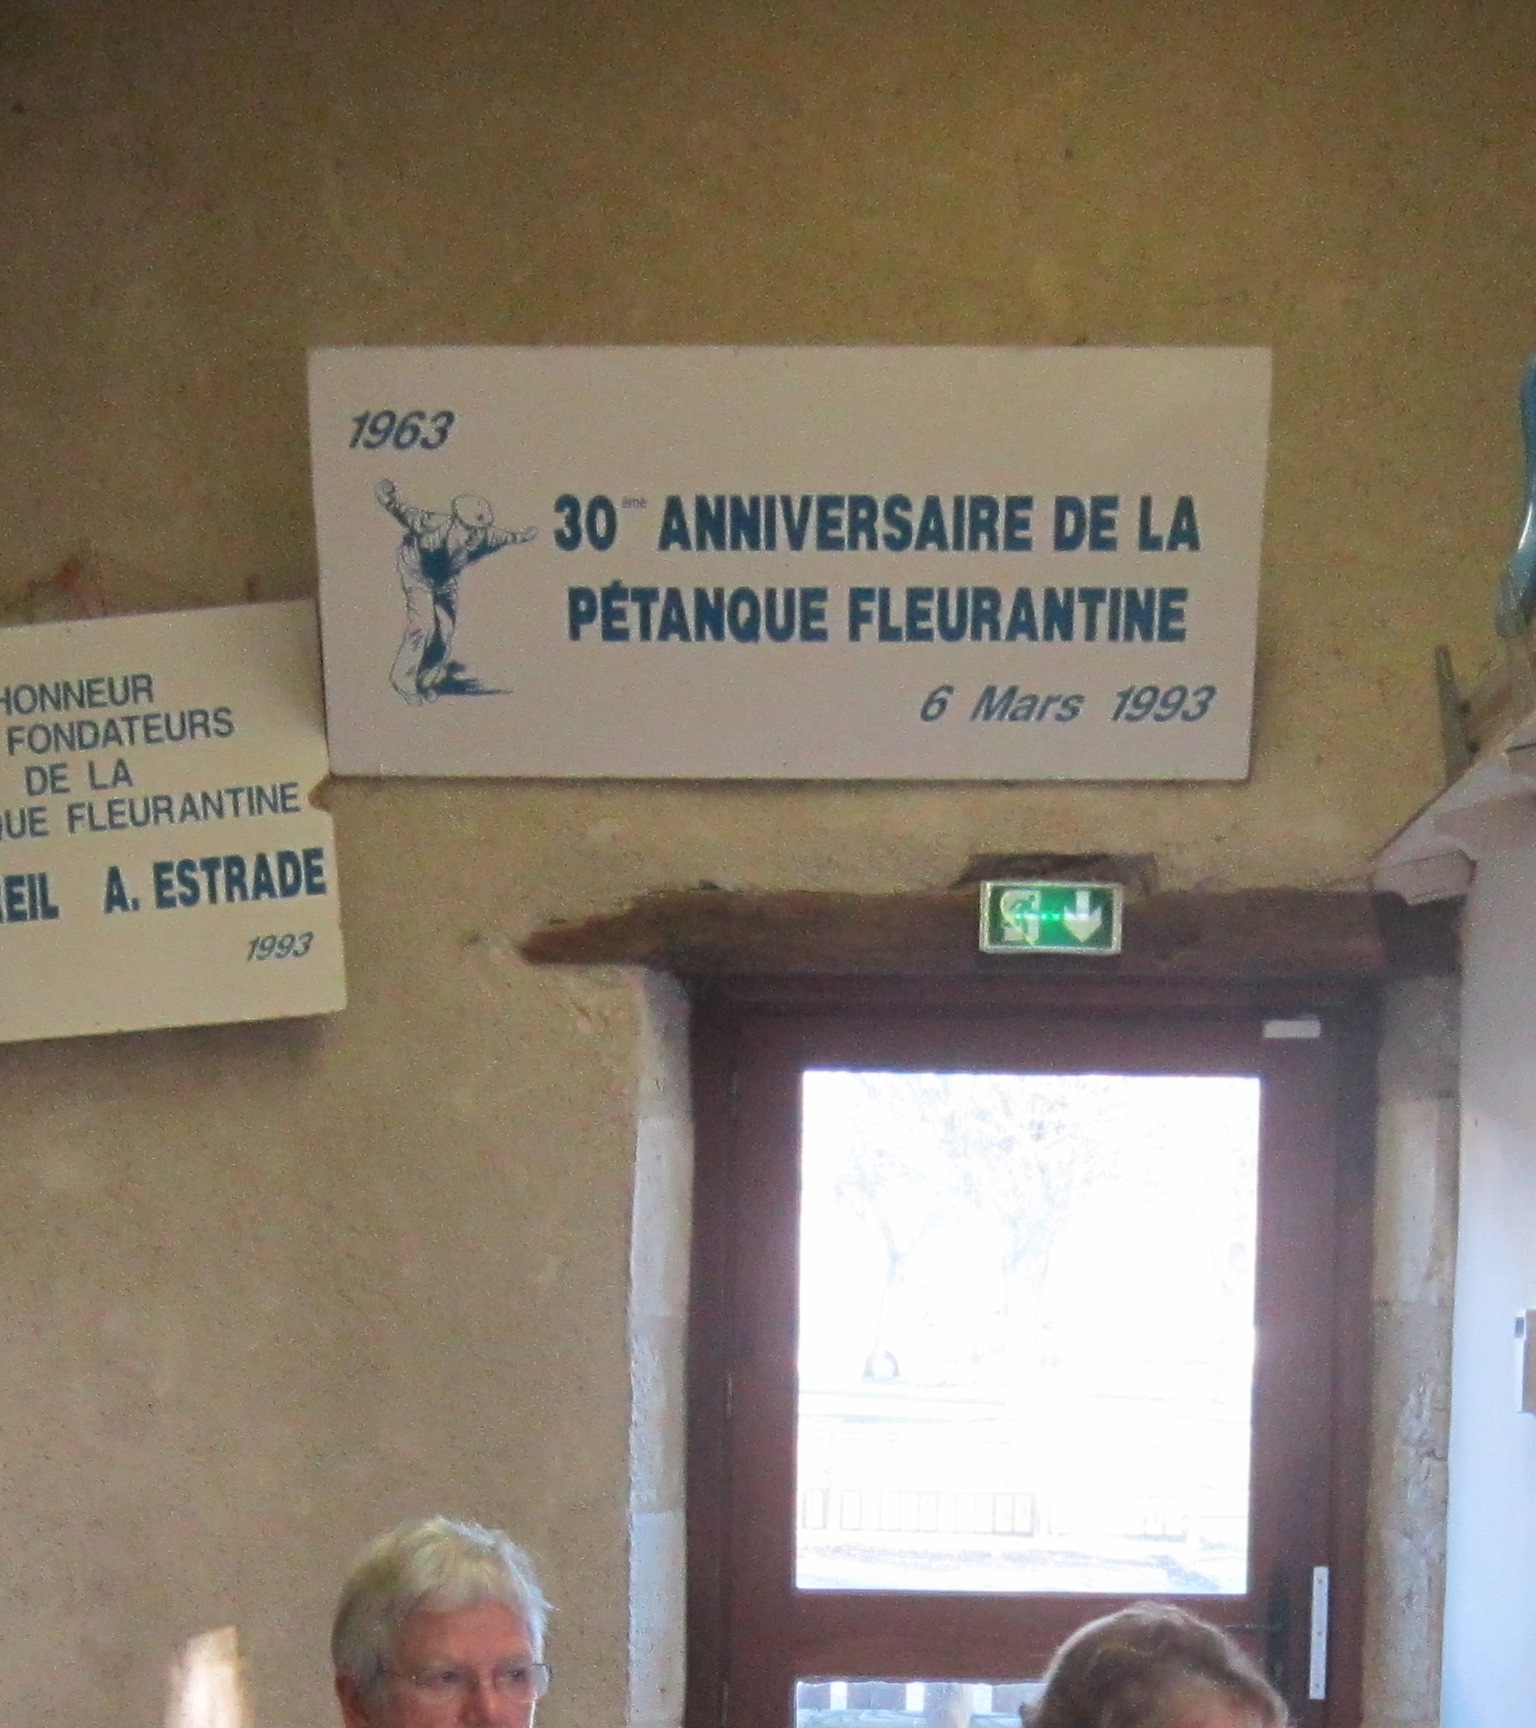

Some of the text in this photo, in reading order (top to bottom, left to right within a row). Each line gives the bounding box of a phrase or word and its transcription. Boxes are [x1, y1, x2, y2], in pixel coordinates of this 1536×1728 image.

[347, 409, 455, 452] 1963
[658, 493, 1033, 553] ANNIVERSAIRE
[1053, 494, 1120, 553] DE
[1138, 494, 1201, 553] LA
[567, 579, 1188, 644] PÉTANQUE FLEURANTINE
[918, 685, 1217, 725] 6 Mars 1993
[6, 706, 236, 757] FONDATEURS
[25, 758, 134, 797] DE LA
[67, 781, 302, 835] FLEURANTINE
[103, 847, 328, 914] A. ESTRADE
[246, 932, 315, 961] 1993
